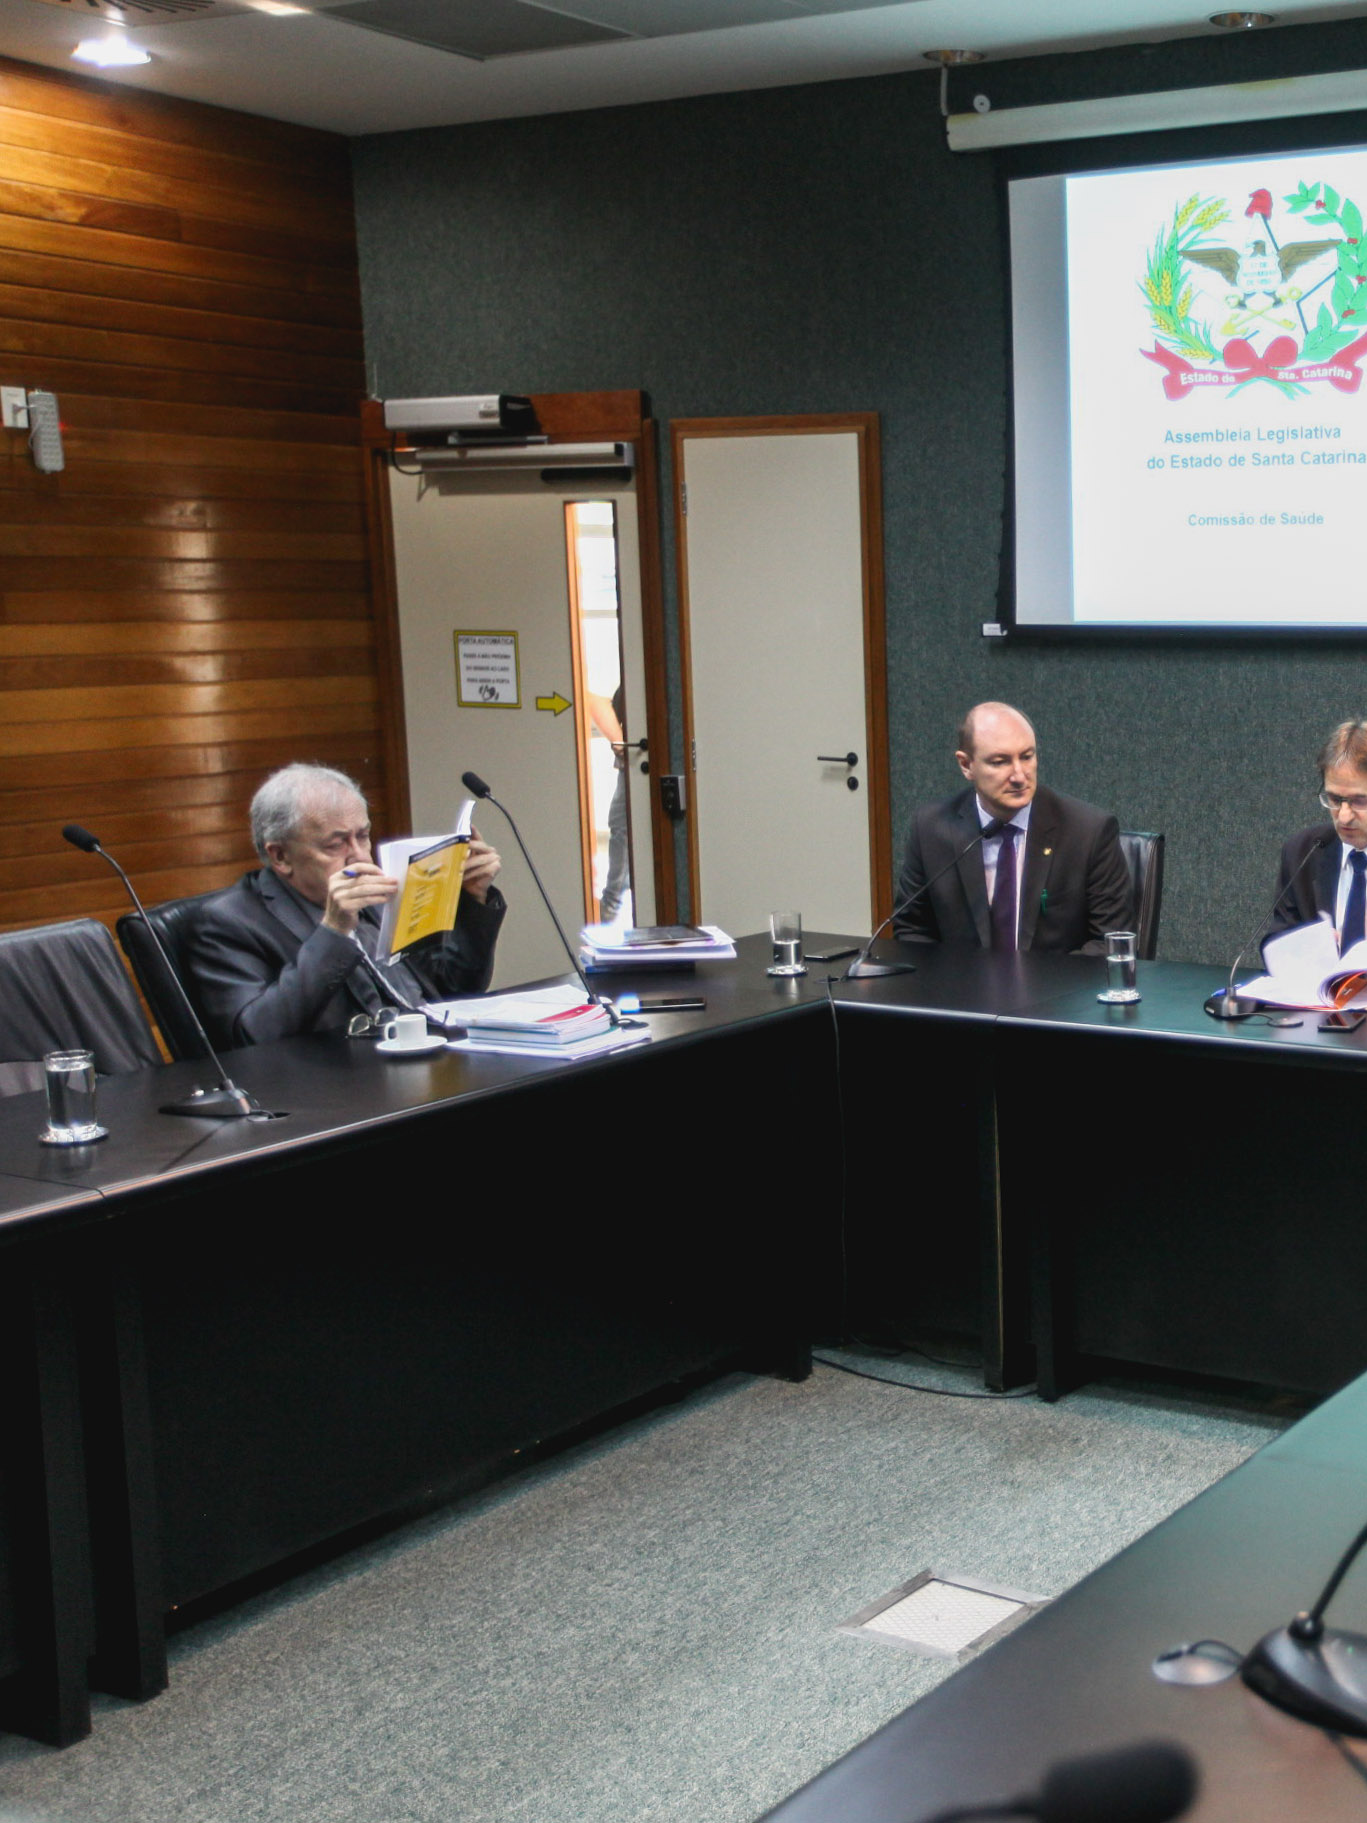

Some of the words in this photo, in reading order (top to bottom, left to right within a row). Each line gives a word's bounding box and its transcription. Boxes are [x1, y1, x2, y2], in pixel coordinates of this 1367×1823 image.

[1180, 373, 1219, 385] Estado
[1302, 366, 1352, 380] Catarina
[1164, 427, 1251, 444] Assembleia
[1257, 425, 1341, 444] Legislativa
[1147, 456, 1165, 470] do
[1170, 453, 1222, 469] Estado
[1228, 452, 1246, 467] de
[1252, 451, 1295, 467] Santa
[1300, 449, 1367, 466] Catarina
[1188, 511, 1255, 526] Comissão
[1260, 512, 1276, 525] de
